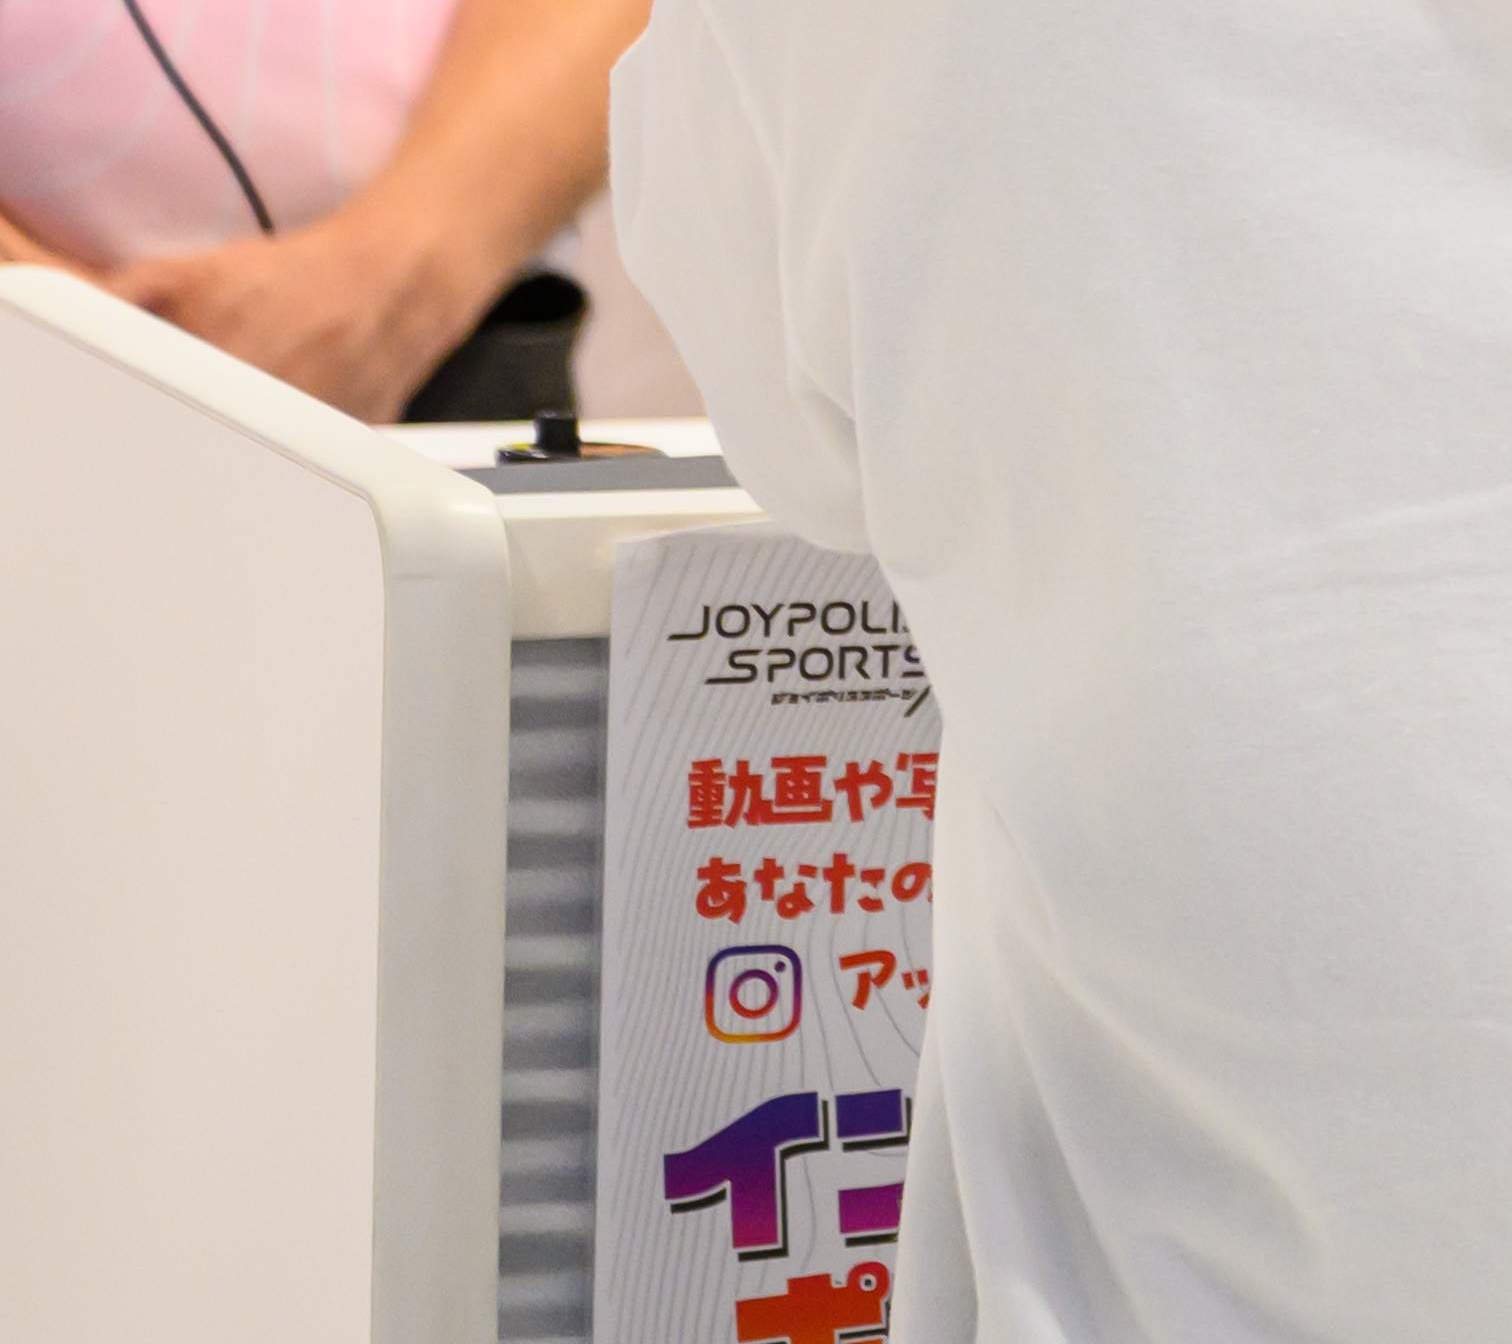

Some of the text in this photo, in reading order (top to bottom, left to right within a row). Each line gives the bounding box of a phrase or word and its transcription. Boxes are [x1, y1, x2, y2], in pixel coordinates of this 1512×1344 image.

[667, 600, 909, 641] JOYPOLI
[696, 853, 932, 924] あなたの
